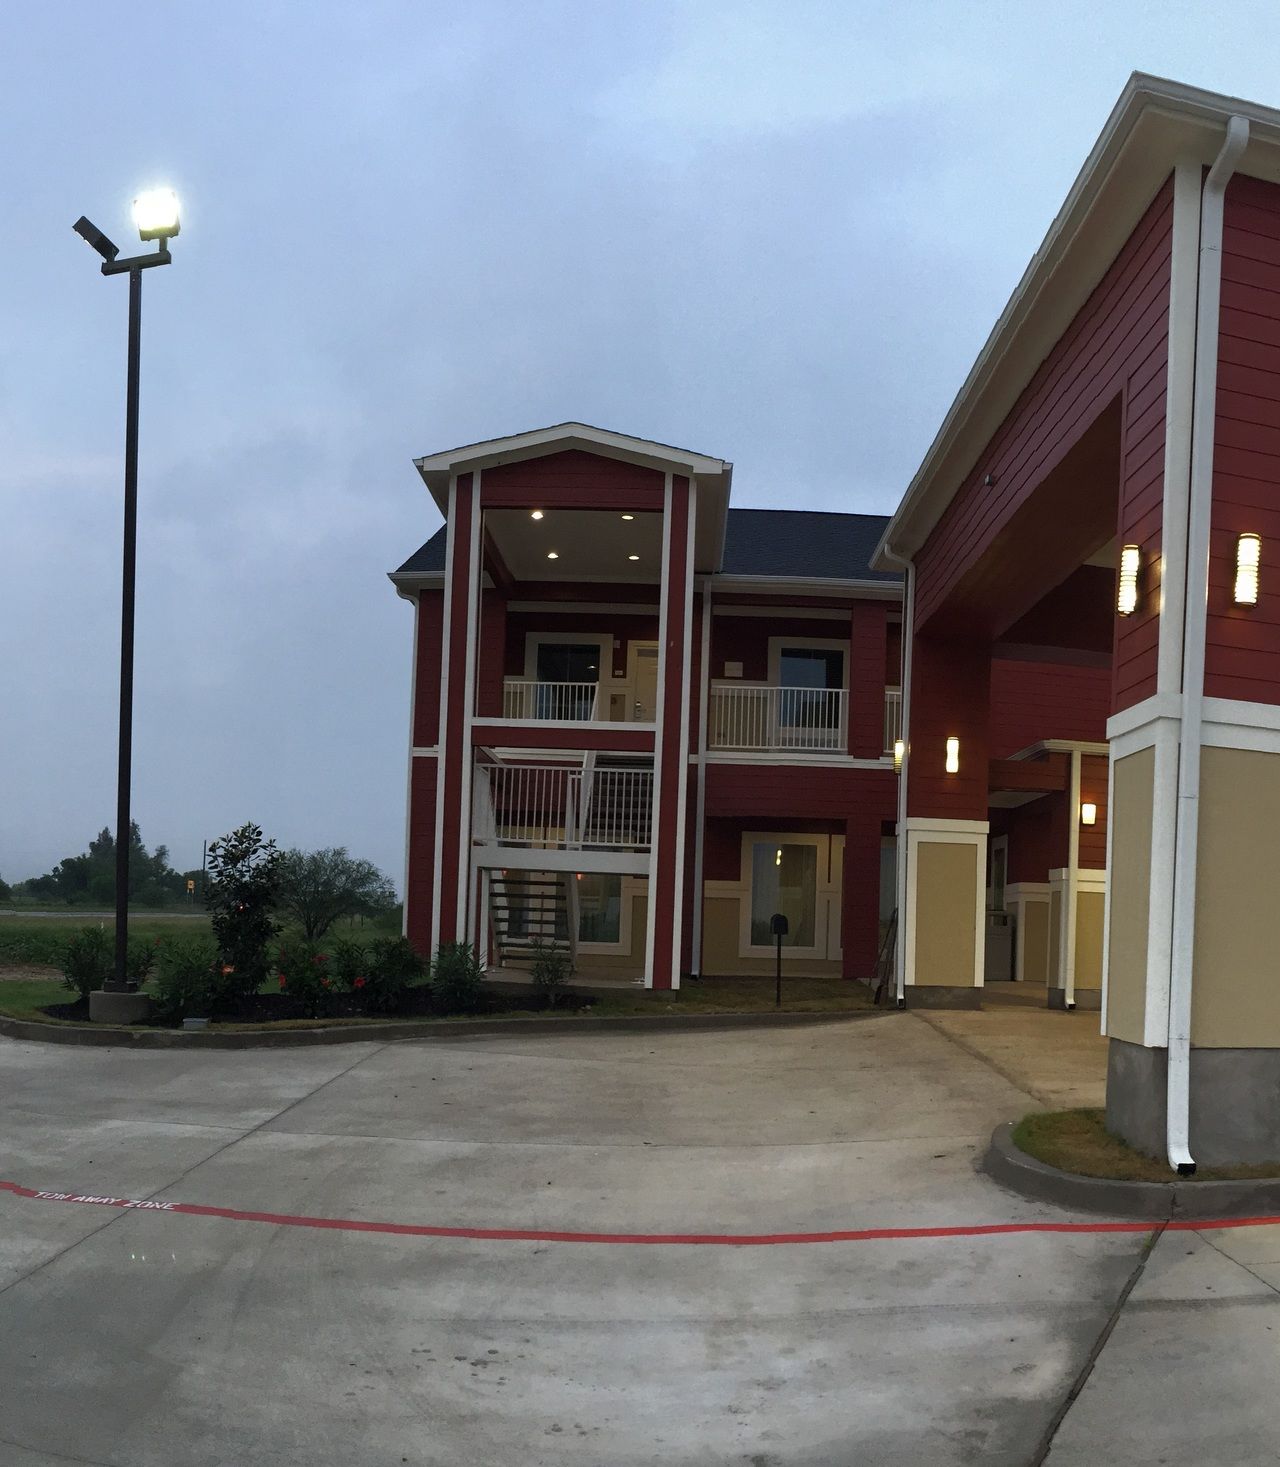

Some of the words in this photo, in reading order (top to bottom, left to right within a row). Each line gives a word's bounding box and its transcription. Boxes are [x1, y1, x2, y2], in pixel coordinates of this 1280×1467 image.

[34, 1191, 72, 1201] TOW
[72, 1195, 122, 1204] AWAY
[123, 1199, 181, 1210] ZONE
